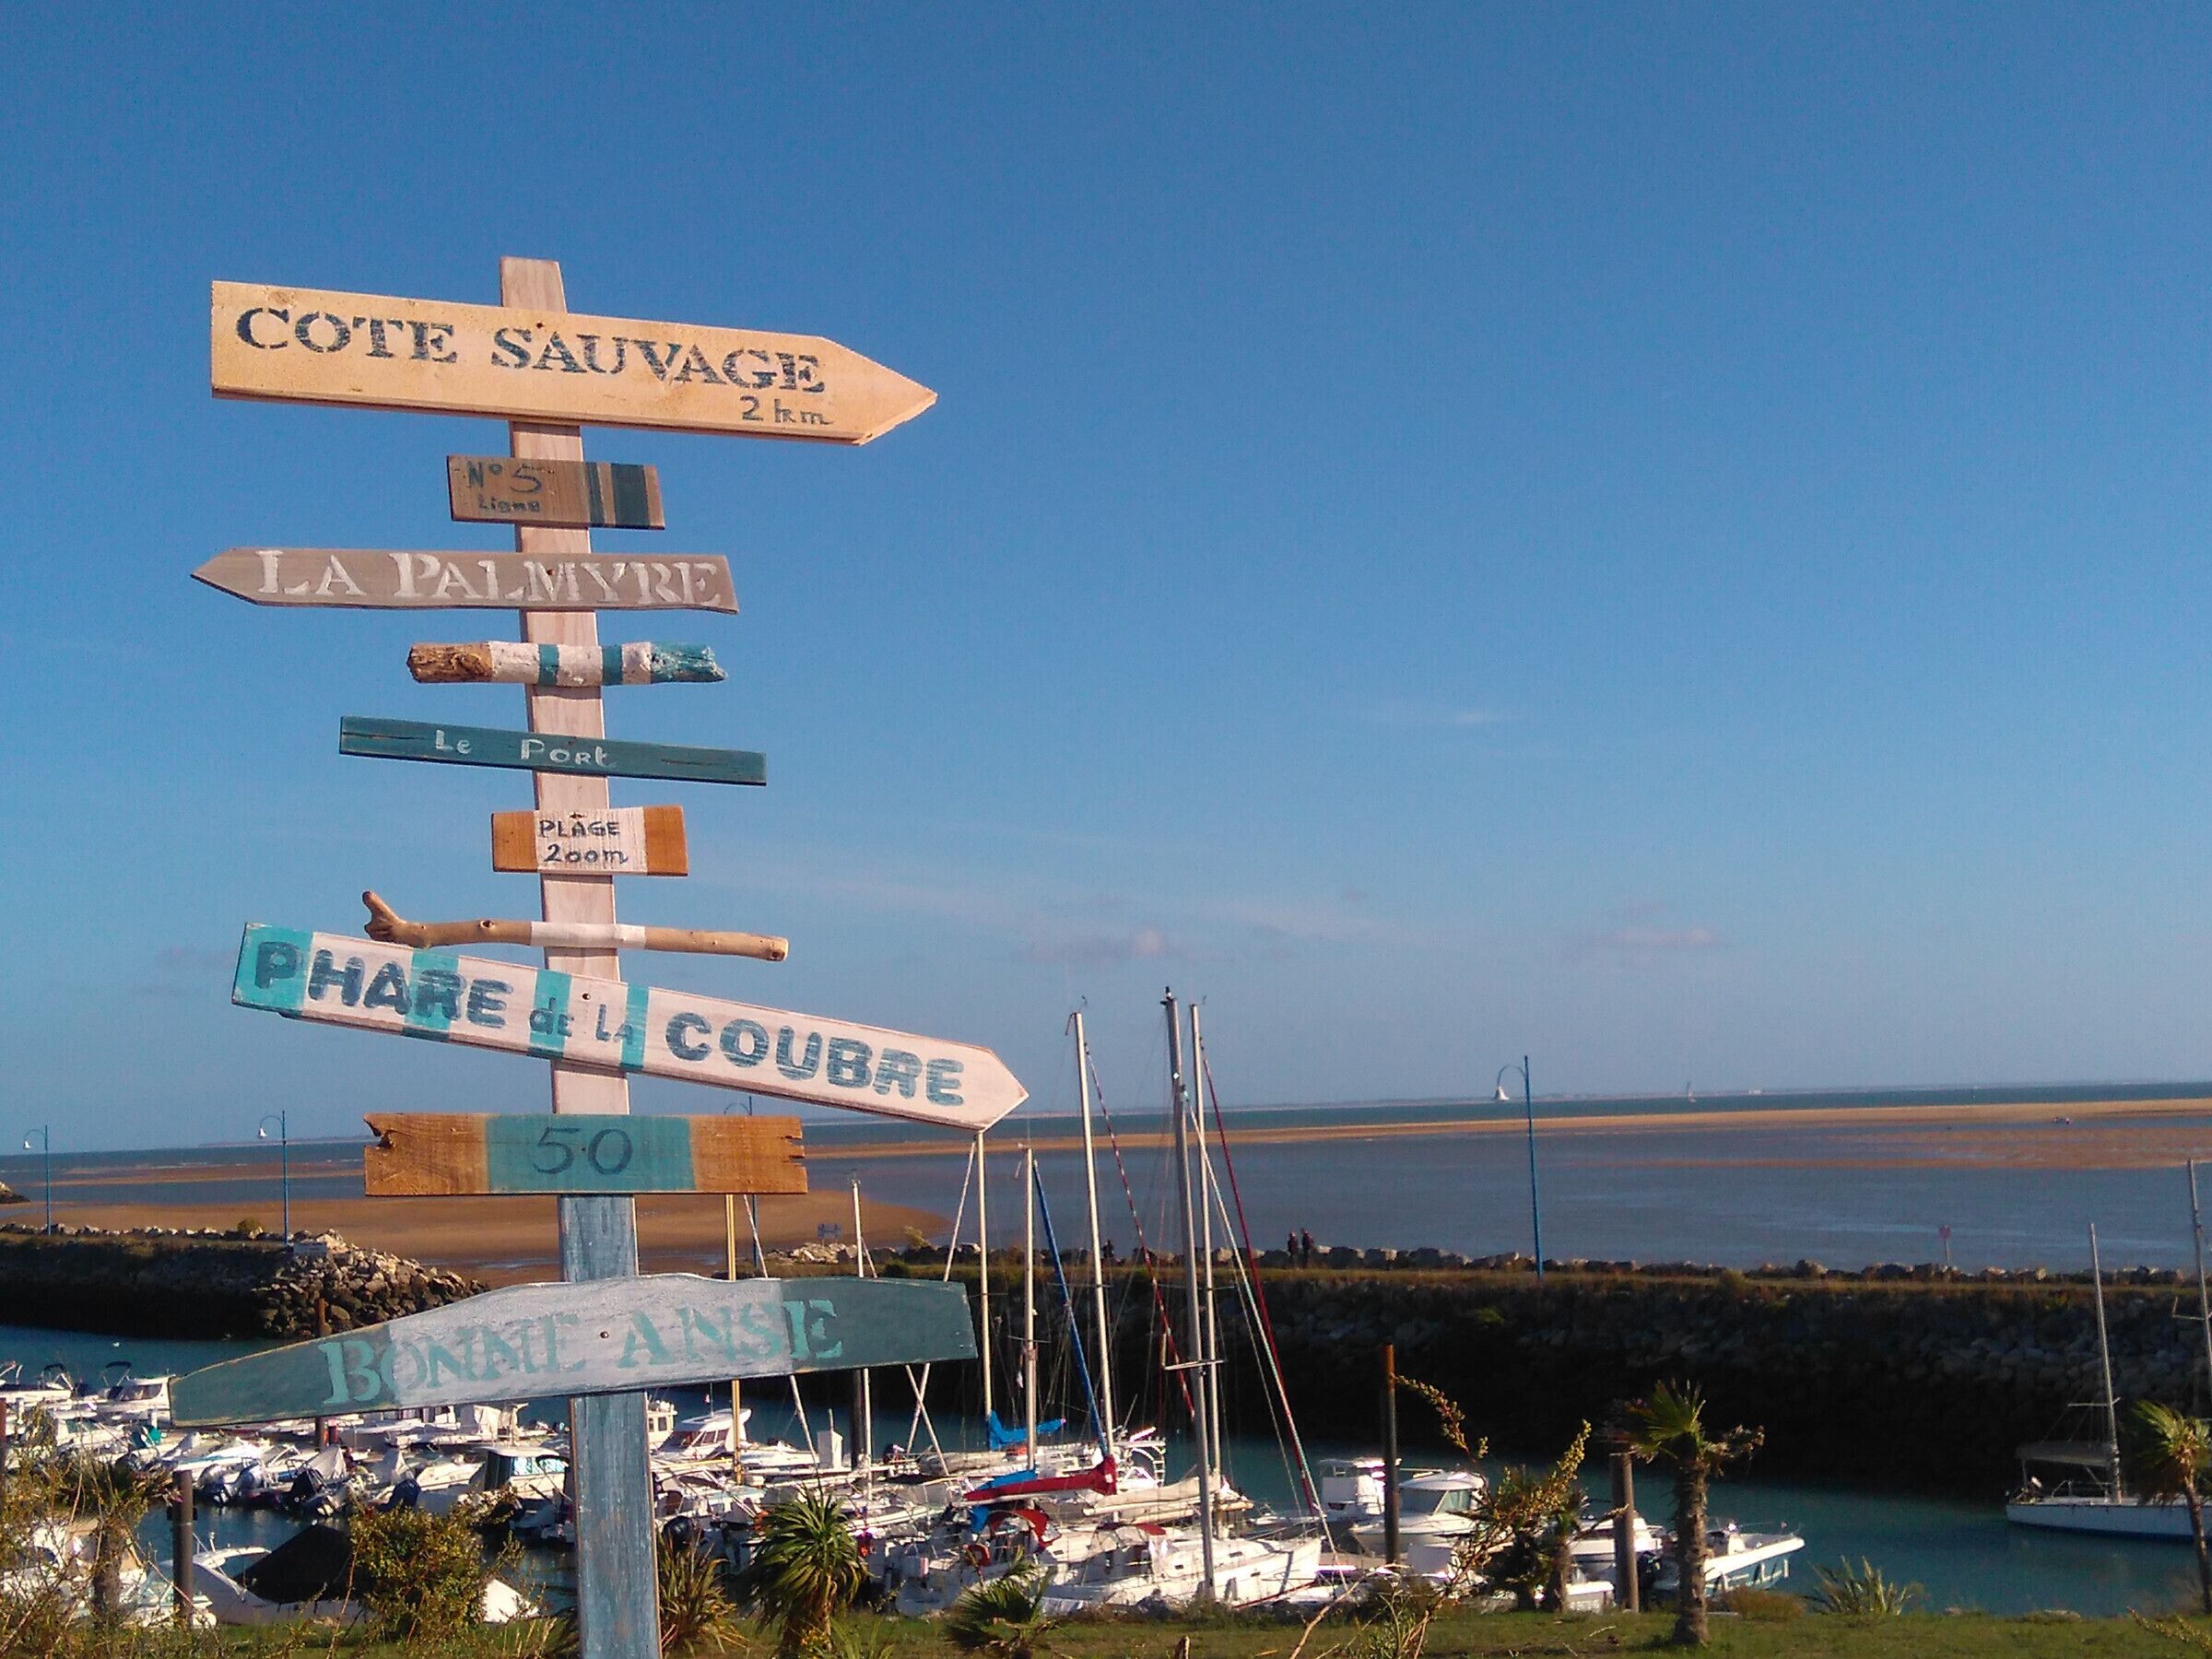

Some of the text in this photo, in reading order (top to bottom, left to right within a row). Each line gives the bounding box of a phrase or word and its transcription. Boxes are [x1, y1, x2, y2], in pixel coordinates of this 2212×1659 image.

[235, 307, 826, 394] COTE SAUVAGE
[739, 395, 834, 425] 2 km
[509, 463, 546, 494] 5
[254, 549, 722, 607] LA PALMYRE
[435, 730, 472, 756] Le
[254, 940, 513, 1029] PHARE
[665, 1012, 966, 1107] COUBRE
[317, 1299, 844, 1406] BONNE ANSE
